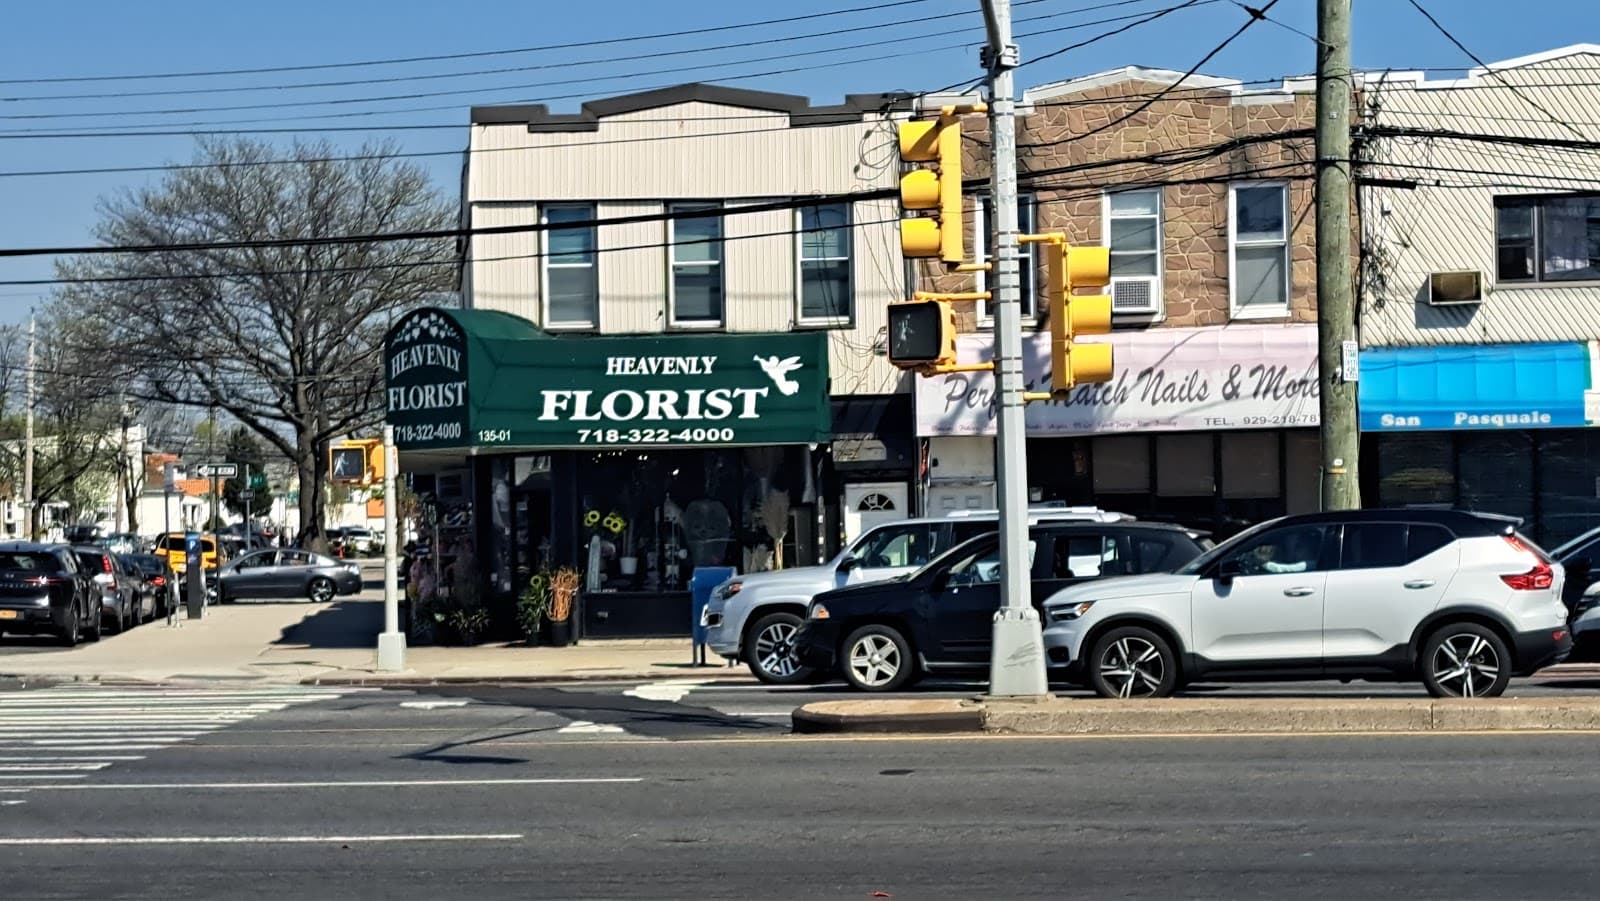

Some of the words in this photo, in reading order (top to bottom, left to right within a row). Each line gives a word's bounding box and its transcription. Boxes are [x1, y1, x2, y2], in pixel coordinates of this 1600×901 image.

[391, 344, 462, 379] HEAVENLY
[605, 356, 718, 375] HEAVENLY
[1137, 366, 1210, 406] Nails
[1222, 363, 1242, 401] &
[1249, 363, 1320, 401] More
[388, 380, 467, 412] FLORIST
[537, 387, 769, 421] FLORIST
[1243, 414, 1320, 425] 929-218-78
[1380, 413, 1421, 427] San
[1454, 411, 1552, 427] Pasquale
[395, 422, 462, 442] 718-322-4000
[478, 429, 511, 442] 135-01
[577, 428, 735, 443] 718-322-4000
